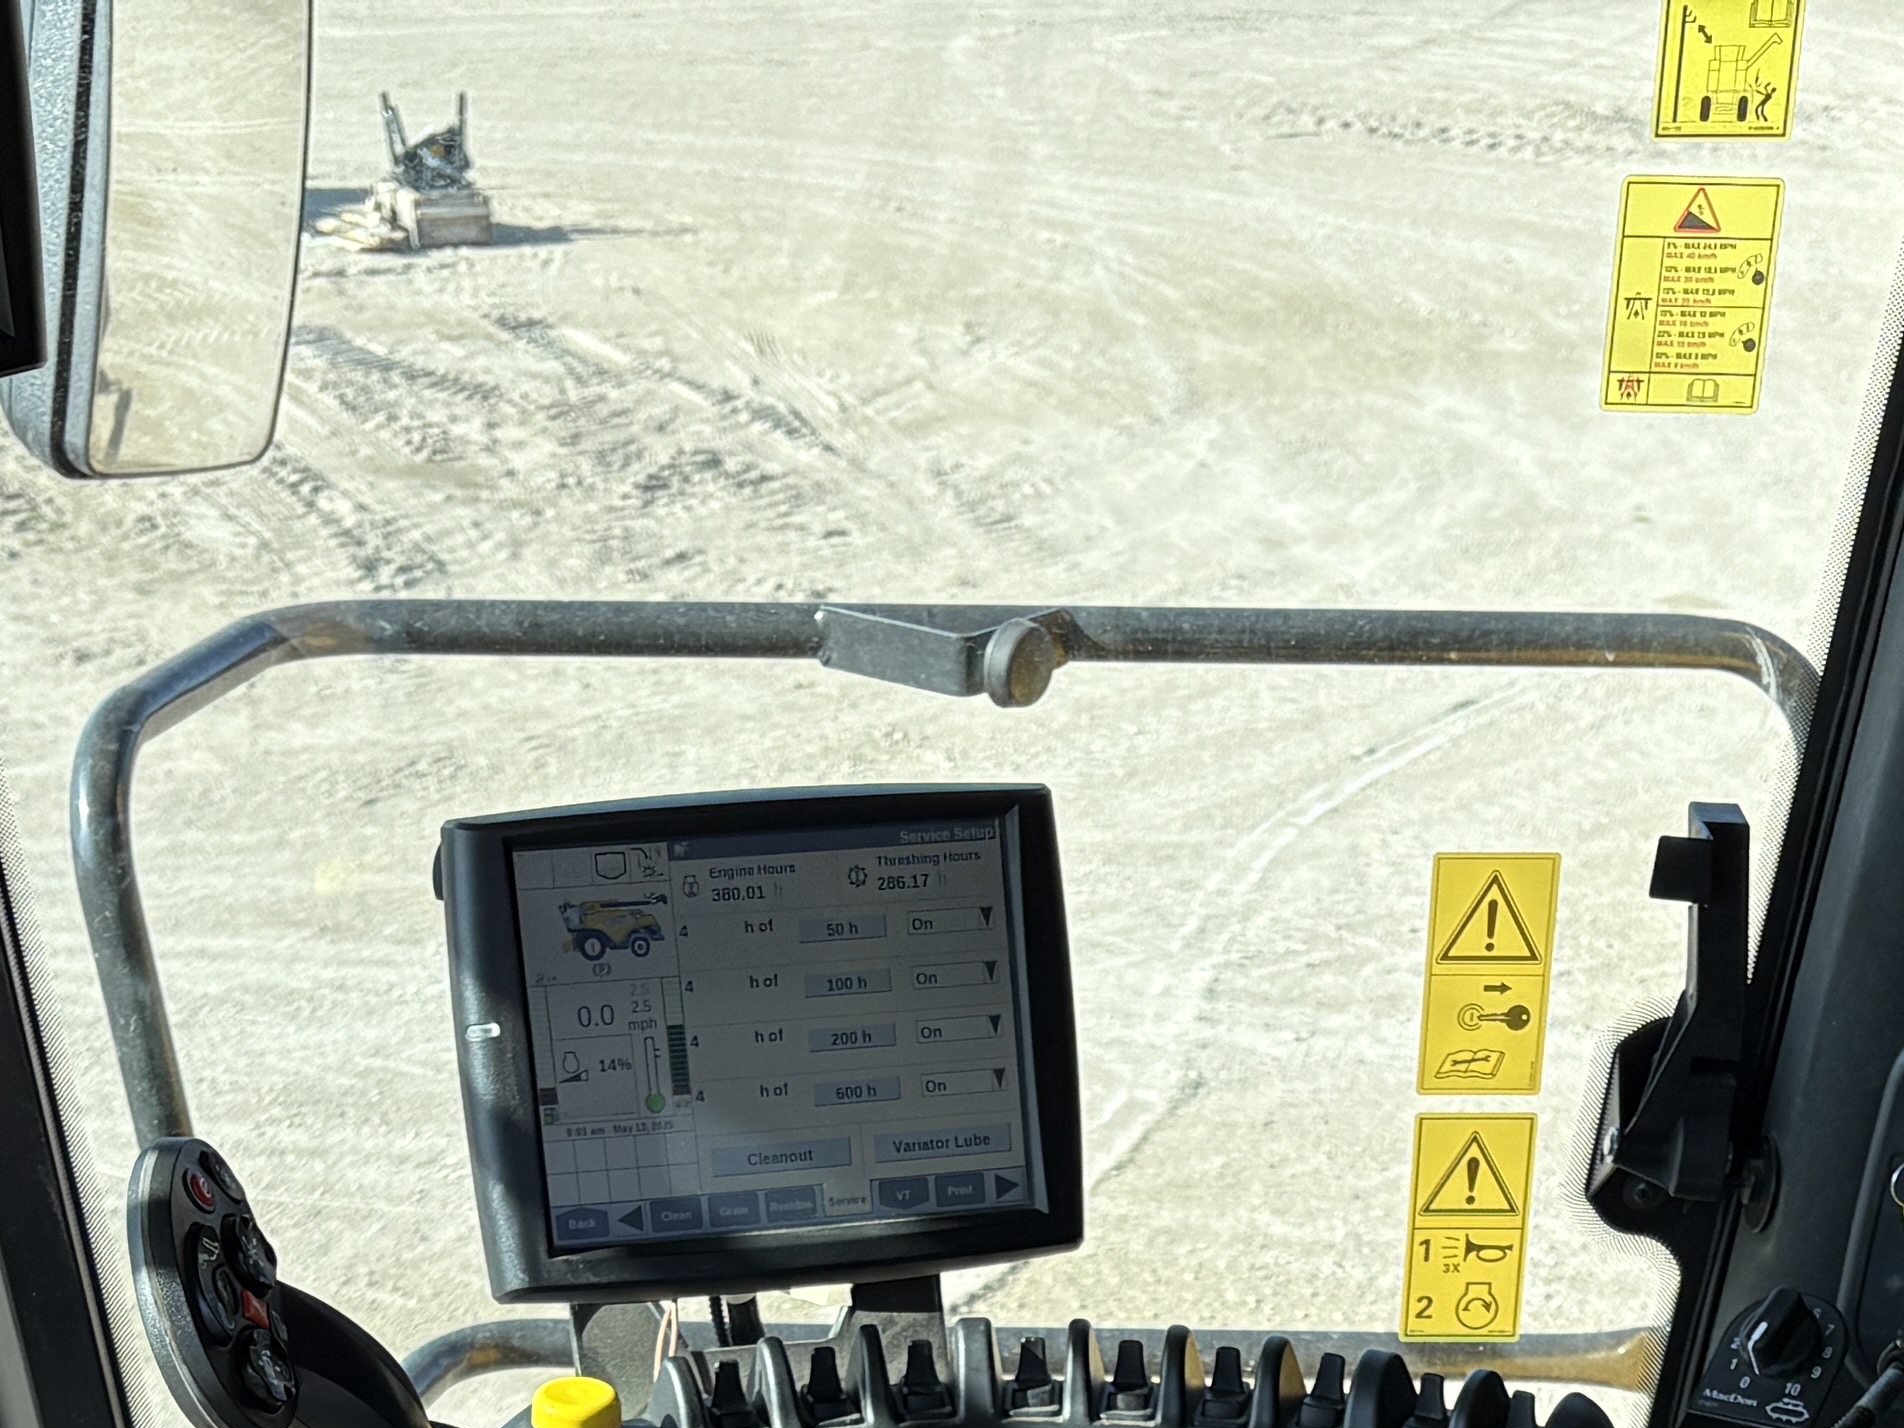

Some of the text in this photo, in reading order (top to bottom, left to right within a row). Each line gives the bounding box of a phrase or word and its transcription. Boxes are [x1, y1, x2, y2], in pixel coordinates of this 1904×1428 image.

[900, 825, 994, 843] Service Setup
[877, 850, 981, 868] Threshing Hours
[709, 863, 796, 881] Engine Hours
[877, 873, 929, 891] 286.17
[679, 918, 773, 937] 4 h of
[827, 921, 858, 936] 50 h
[912, 918, 933, 931] On
[685, 973, 778, 993] 4 h of
[827, 976, 867, 992] 100 h
[916, 972, 938, 985] On
[631, 1000, 652, 1013] 2.5
[578, 1004, 614, 1027] 0.0
[628, 1018, 657, 1032] mph
[690, 1028, 784, 1048] 4 h of
[831, 1030, 872, 1046] 200 h
[921, 1026, 942, 1039] On
[599, 1057, 632, 1073] 14%
[695, 1083, 788, 1102] 4 h of
[867, 1085, 876, 1098] h
[925, 1080, 947, 1093] On
[590, 1127, 605, 1137] am
[614, 1123, 633, 1135] May
[893, 1133, 991, 1154] Variator Lube
[747, 1148, 814, 1167] Cleanout
[947, 1185, 973, 1197] Print
[829, 1195, 866, 1207] Service
[568, 1218, 595, 1231] Back
[1419, 1239, 1431, 1262] 1
[1442, 1263, 1460, 1273] 3X
[1415, 1296, 1433, 1319] 2
[1825, 1323, 1835, 1336] 7
[1822, 1346, 1833, 1359] 8
[1730, 1358, 1739, 1370] 1
[1811, 1366, 1822, 1379] 9
[1740, 1376, 1751, 1389] 0
[1785, 1382, 1801, 1396] 10
[1702, 1387, 1757, 1407] MacDon
